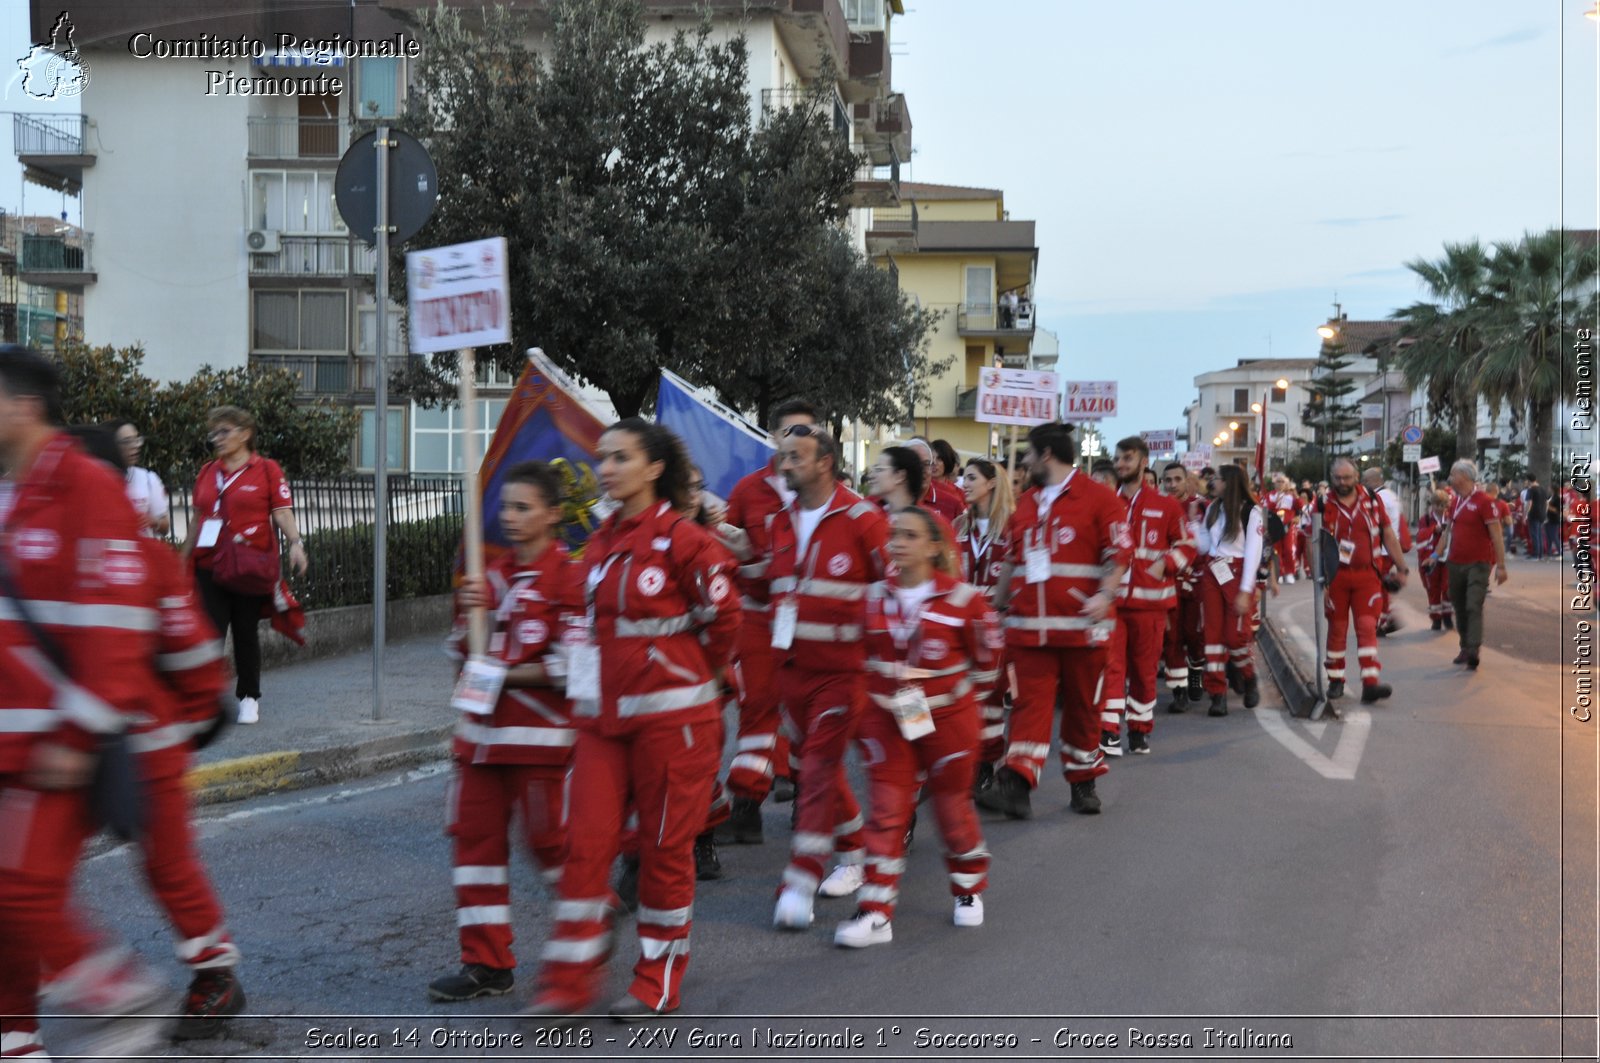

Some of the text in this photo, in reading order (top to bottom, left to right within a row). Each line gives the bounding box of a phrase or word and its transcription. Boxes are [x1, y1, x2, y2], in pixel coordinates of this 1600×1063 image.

[982, 393, 1053, 420] CAMPANIA
[1068, 397, 1116, 413] LAZIO
[1145, 440, 1173, 451] ARCHE
